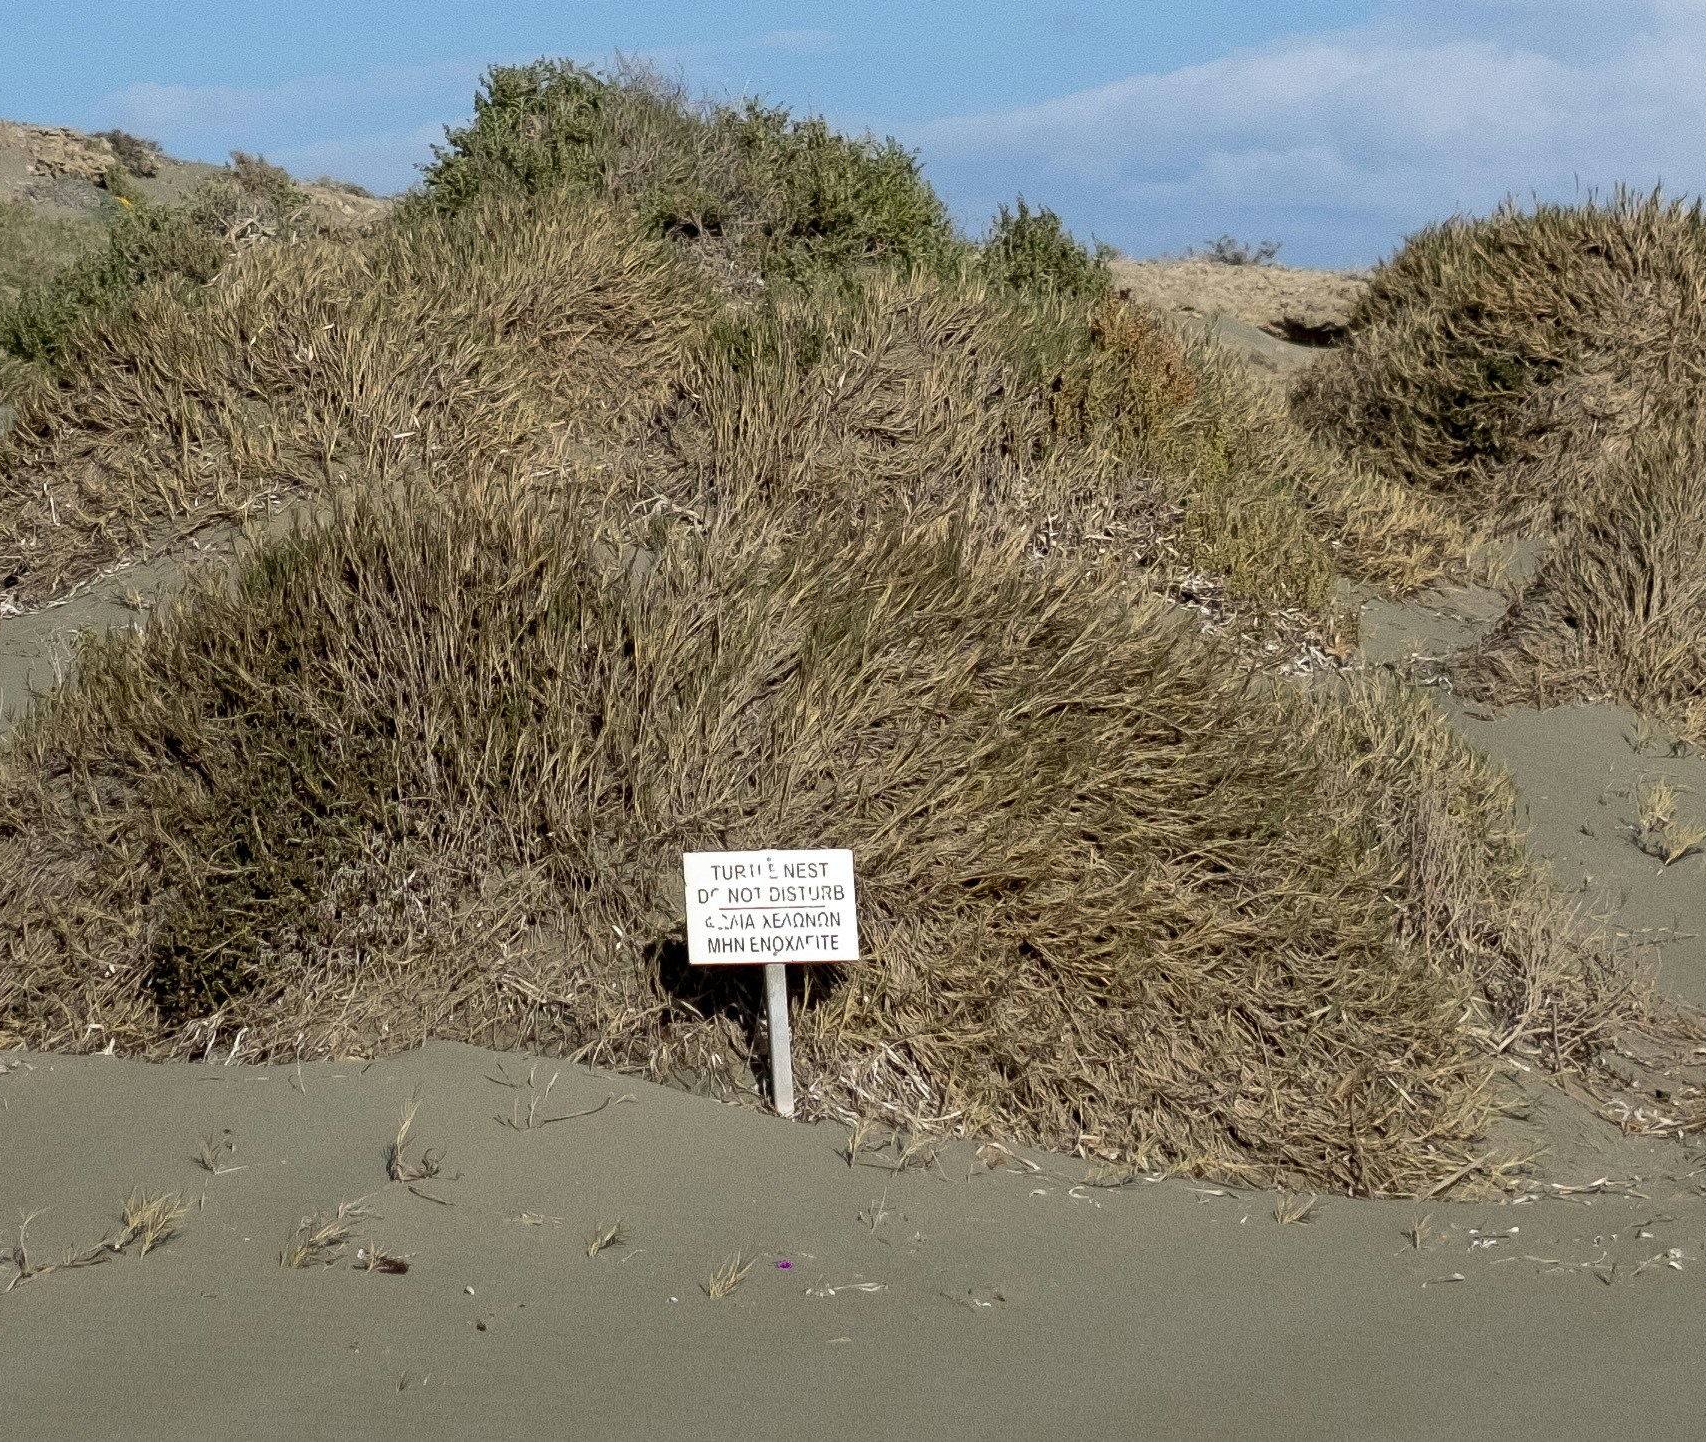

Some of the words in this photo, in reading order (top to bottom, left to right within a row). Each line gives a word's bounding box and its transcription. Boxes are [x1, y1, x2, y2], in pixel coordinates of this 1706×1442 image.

[784, 862, 829, 878] NEST
[728, 887, 761, 903] NOT
[769, 885, 845, 902] DISTURB
[707, 937, 745, 954] ΜΗΝ
